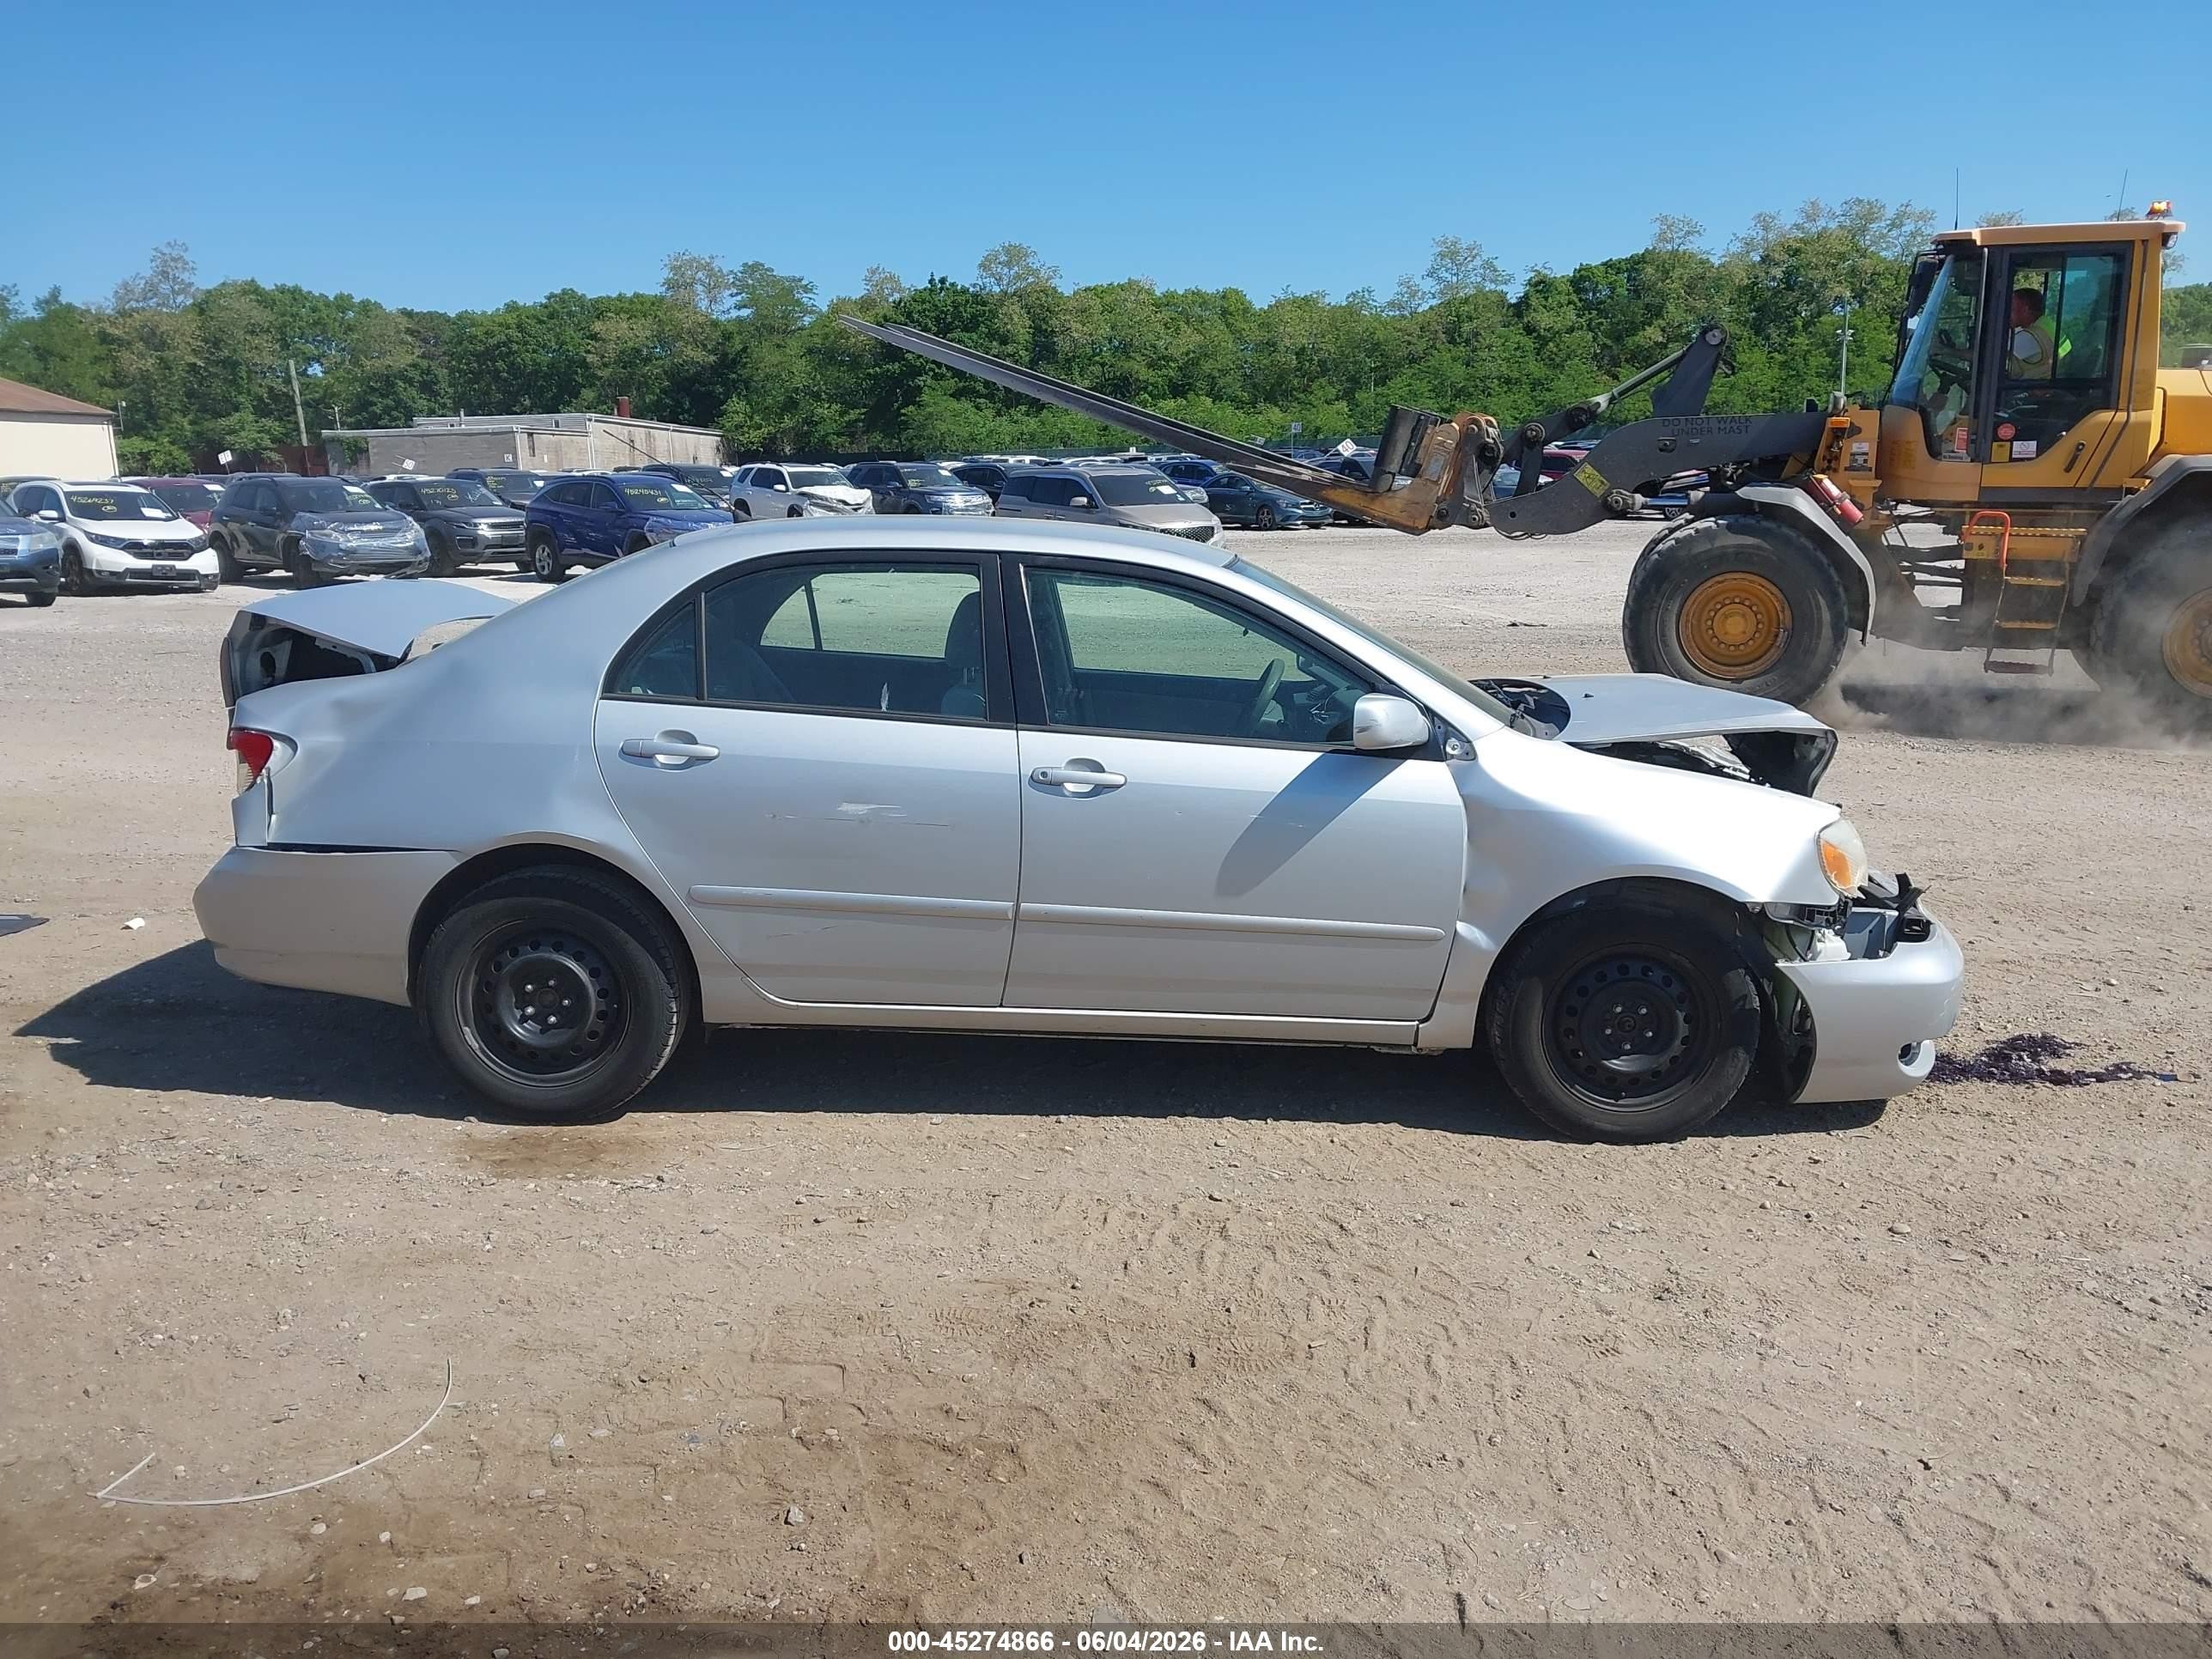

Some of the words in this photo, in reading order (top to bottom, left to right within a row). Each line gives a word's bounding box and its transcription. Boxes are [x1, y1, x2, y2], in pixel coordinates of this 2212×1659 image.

[1662, 418, 1680, 427] DO
[1685, 417, 1710, 426] NOT
[1716, 416, 1753, 425] WALK
[1671, 427, 1712, 436] UNDER
[1717, 425, 1750, 434] MAST
[1341, 441, 1354, 453] 40
